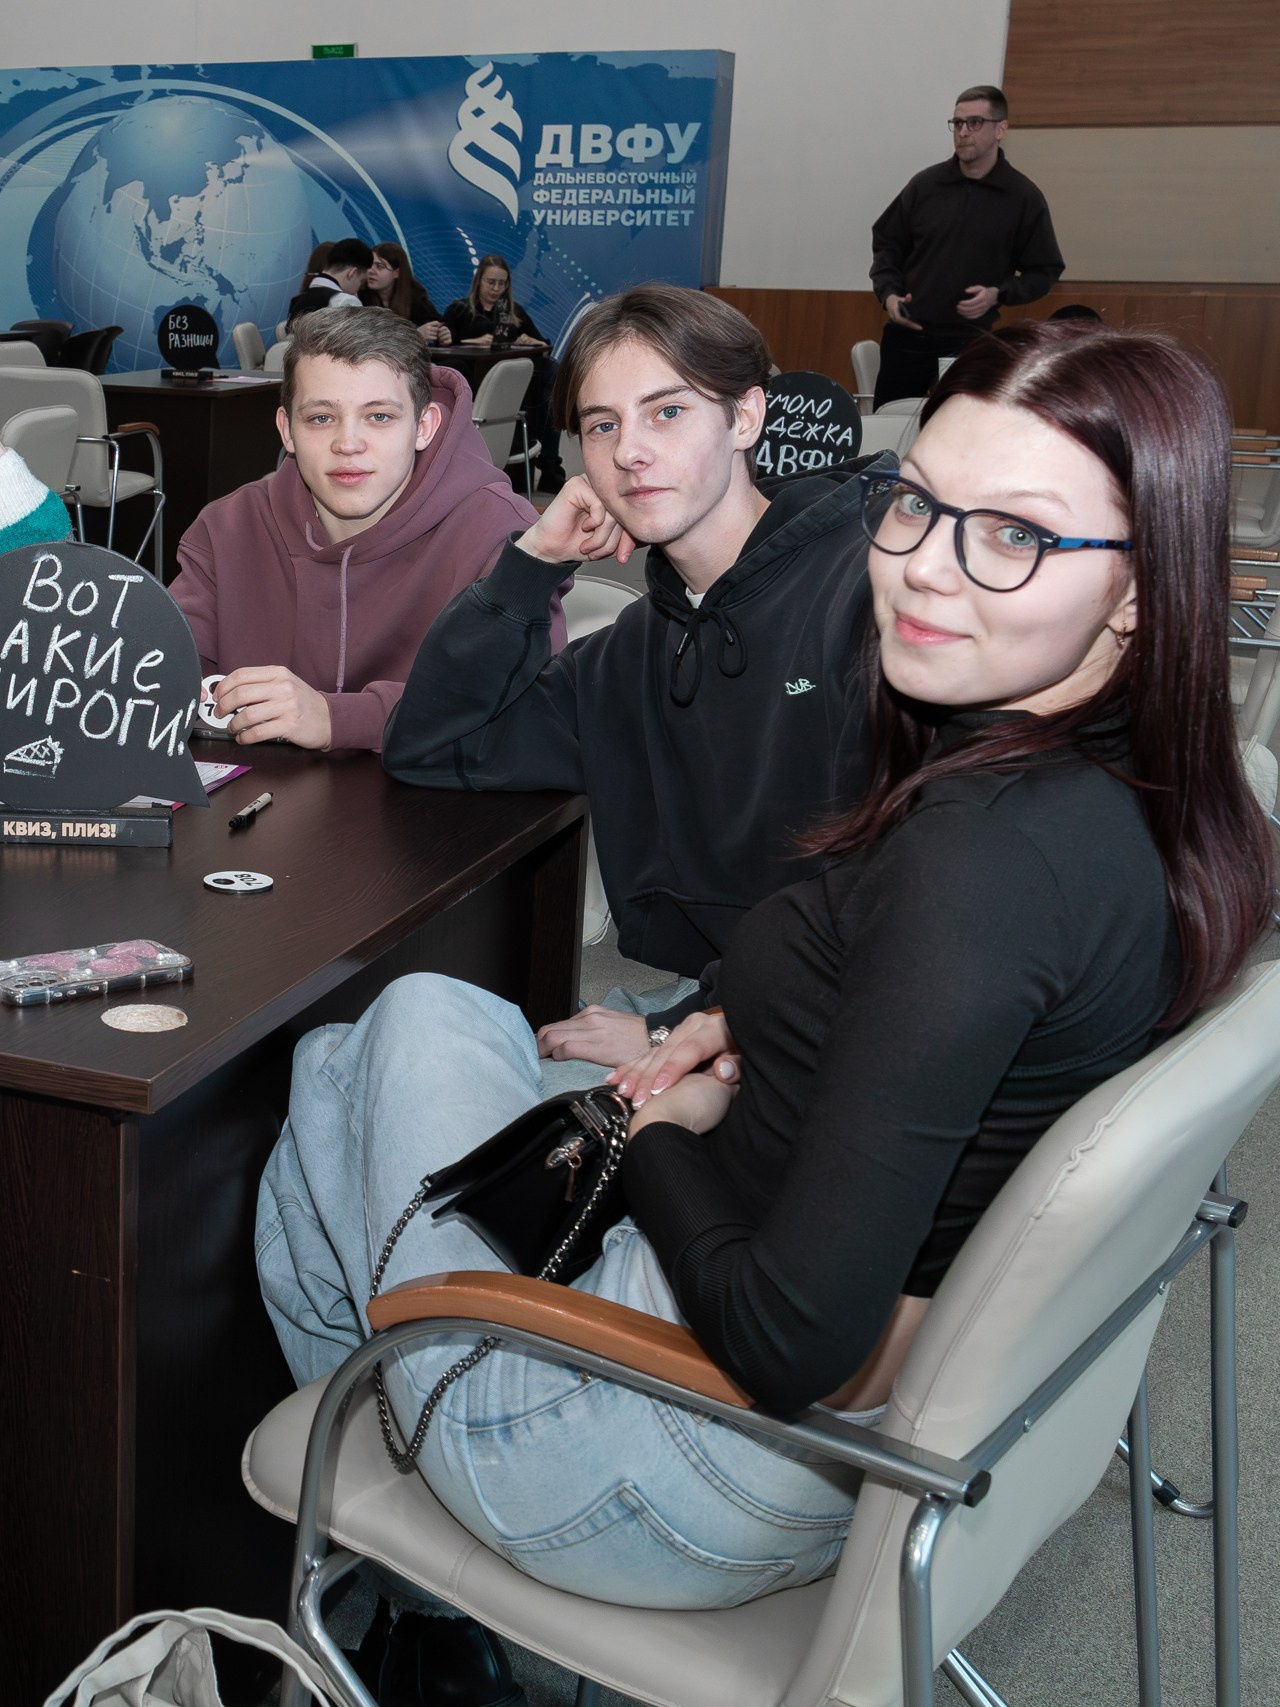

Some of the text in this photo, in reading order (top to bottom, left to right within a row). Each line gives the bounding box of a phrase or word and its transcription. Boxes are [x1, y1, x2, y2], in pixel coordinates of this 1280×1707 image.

[535, 122, 701, 168] ДВФУ
[533, 169, 697, 185] ДАЛЬНЕВОСТОЧНЫЙ
[532, 185, 696, 205] ФЕДЕРАЛЬНЫЙ
[532, 209, 694, 226] УНИВЕРСИТЕТ
[168, 332, 213, 349] РАЗНИЦЫ
[3, 821, 116, 839] КВИЗ, ПЛИЗ!
